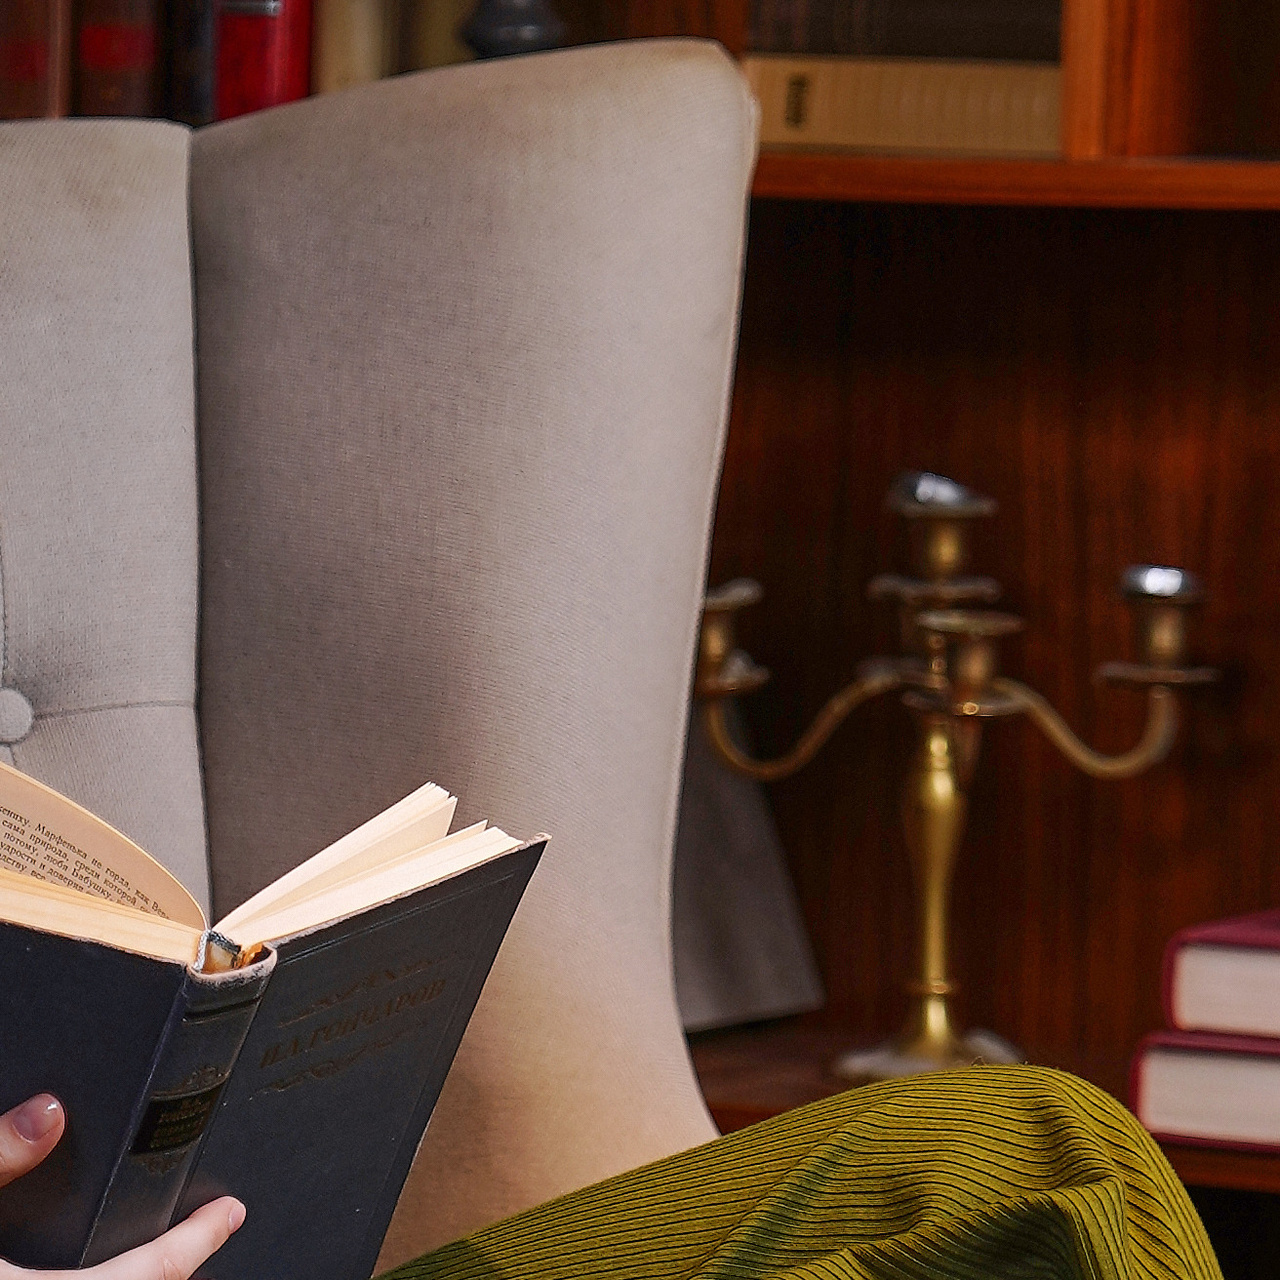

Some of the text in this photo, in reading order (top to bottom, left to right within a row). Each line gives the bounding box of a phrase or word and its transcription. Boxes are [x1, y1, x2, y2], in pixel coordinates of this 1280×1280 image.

[2, 820, 26, 836] сама
[28, 832, 69, 862] природа,
[74, 858, 100, 880] среди
[103, 878, 136, 906] которой
[4, 831, 39, 856] потому,
[43, 852, 68, 872] любя
[35, 823, 88, 859] Марфенька
[105, 868, 131, 890] горда,
[134, 889, 150, 904] как
